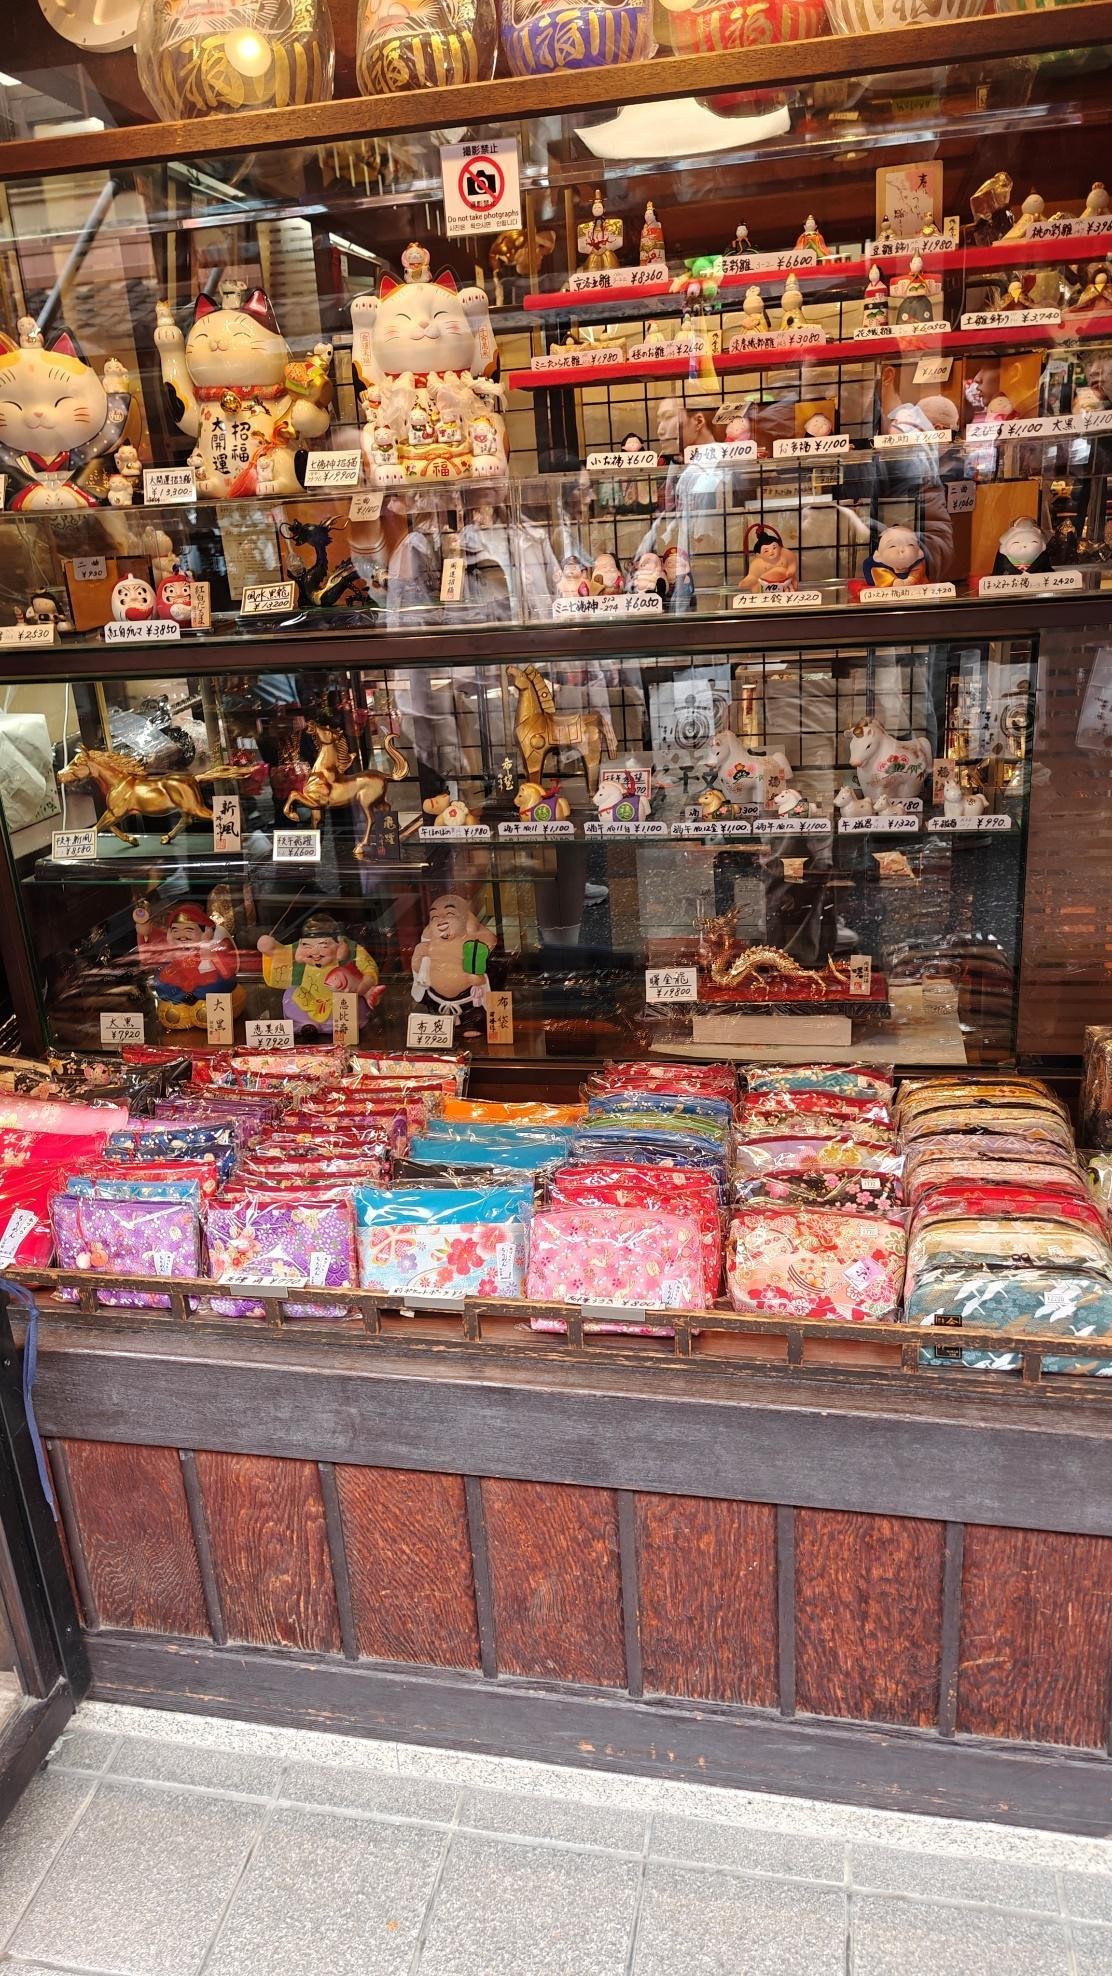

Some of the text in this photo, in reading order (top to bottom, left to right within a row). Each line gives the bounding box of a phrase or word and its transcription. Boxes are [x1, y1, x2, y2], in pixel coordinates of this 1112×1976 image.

[535, 10, 585, 67] 福
[463, 143, 499, 157] 撮影禁止
[470, 213, 482, 221] take
[211, 416, 231, 474] 大開運
[231, 421, 250, 463] 招福
[433, 460, 450, 477] 福
[213, 998, 226, 1032] 大黒
[496, 996, 509, 1029] 布袋
